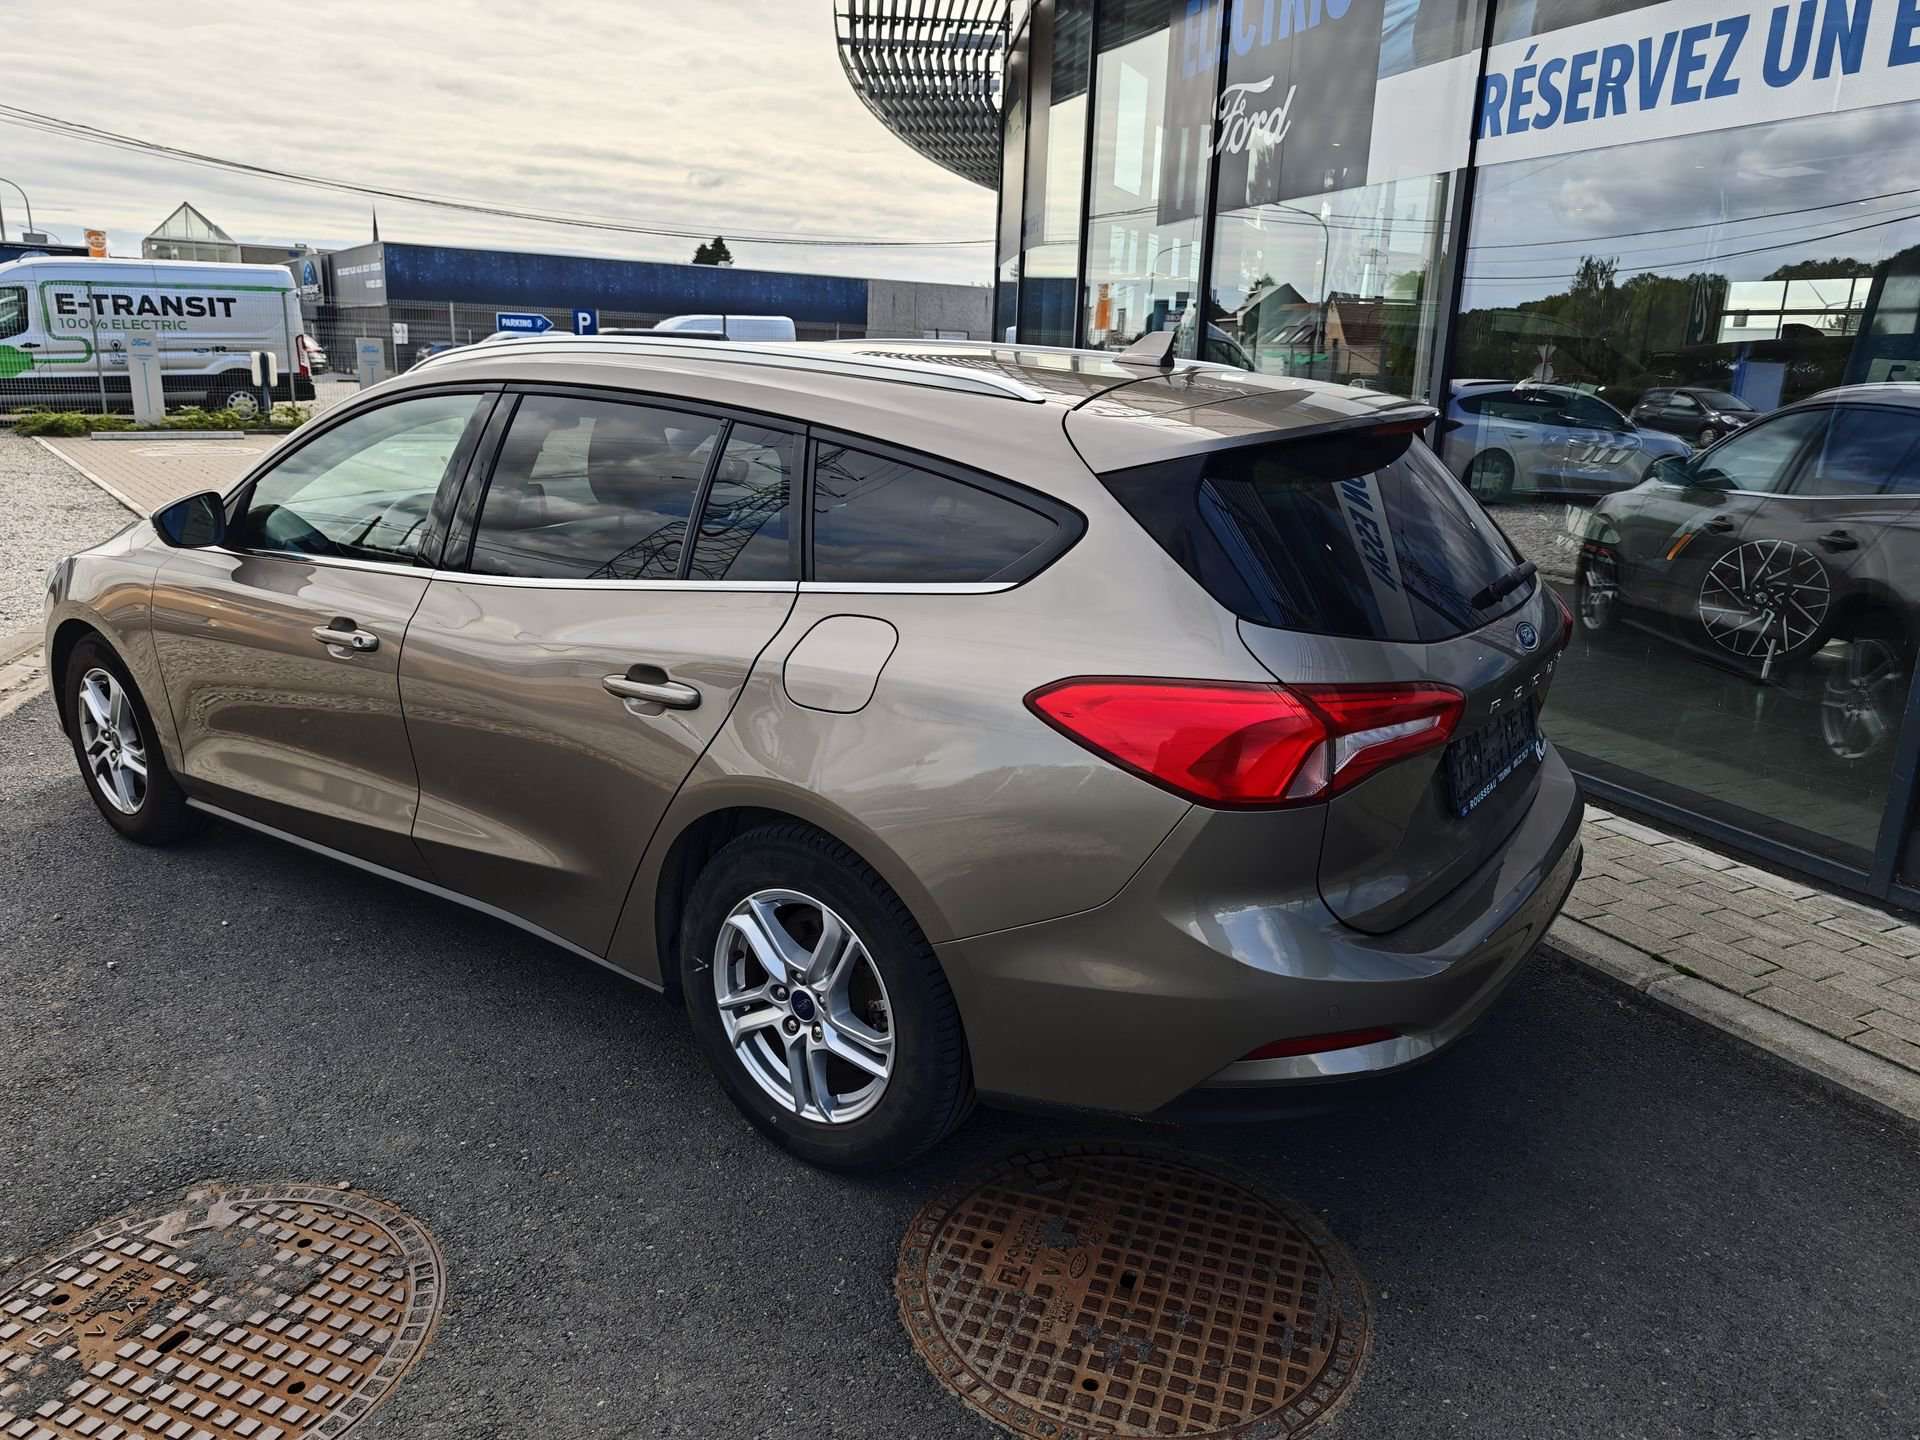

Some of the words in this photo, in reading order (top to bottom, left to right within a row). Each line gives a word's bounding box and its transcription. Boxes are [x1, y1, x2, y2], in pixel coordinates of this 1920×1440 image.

[1477, 14, 1751, 139] RÉSERVEZ
[1762, 0, 1873, 88] UN
[1208, 76, 1296, 158] Ford
[55, 293, 237, 318] E-TRANSIT
[58, 317, 109, 330] 100%
[111, 318, 188, 331] ELECTRIC
[501, 318, 533, 328] PARKING
[1469, 779, 1498, 810] ROUSSEAU
[85, 1299, 150, 1338] VIA
